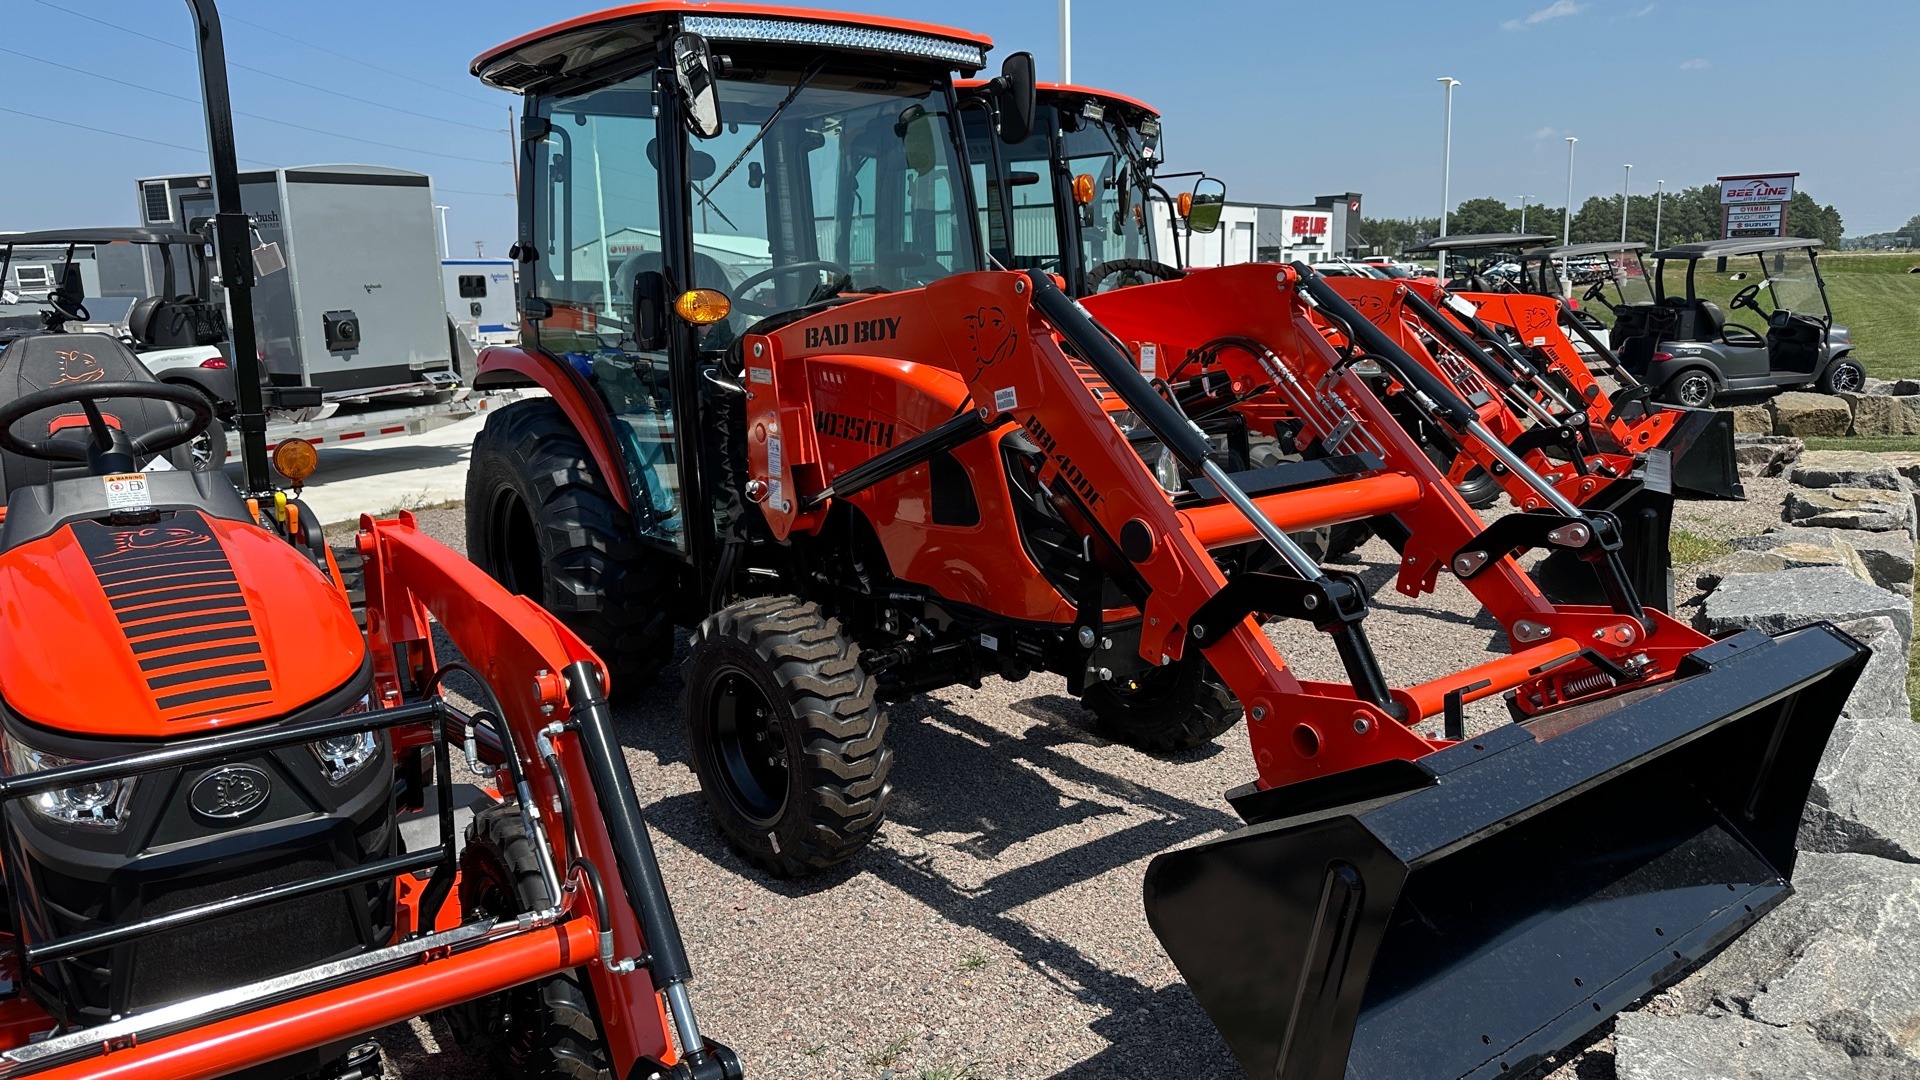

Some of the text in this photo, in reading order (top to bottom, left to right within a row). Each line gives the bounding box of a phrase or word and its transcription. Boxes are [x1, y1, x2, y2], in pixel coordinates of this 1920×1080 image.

[1727, 187, 1787, 197] BEE LINE
[1292, 215, 1328, 235] BEE LINE
[805, 316, 902, 349] BAD BOY
[814, 410, 895, 449] 4035CH
